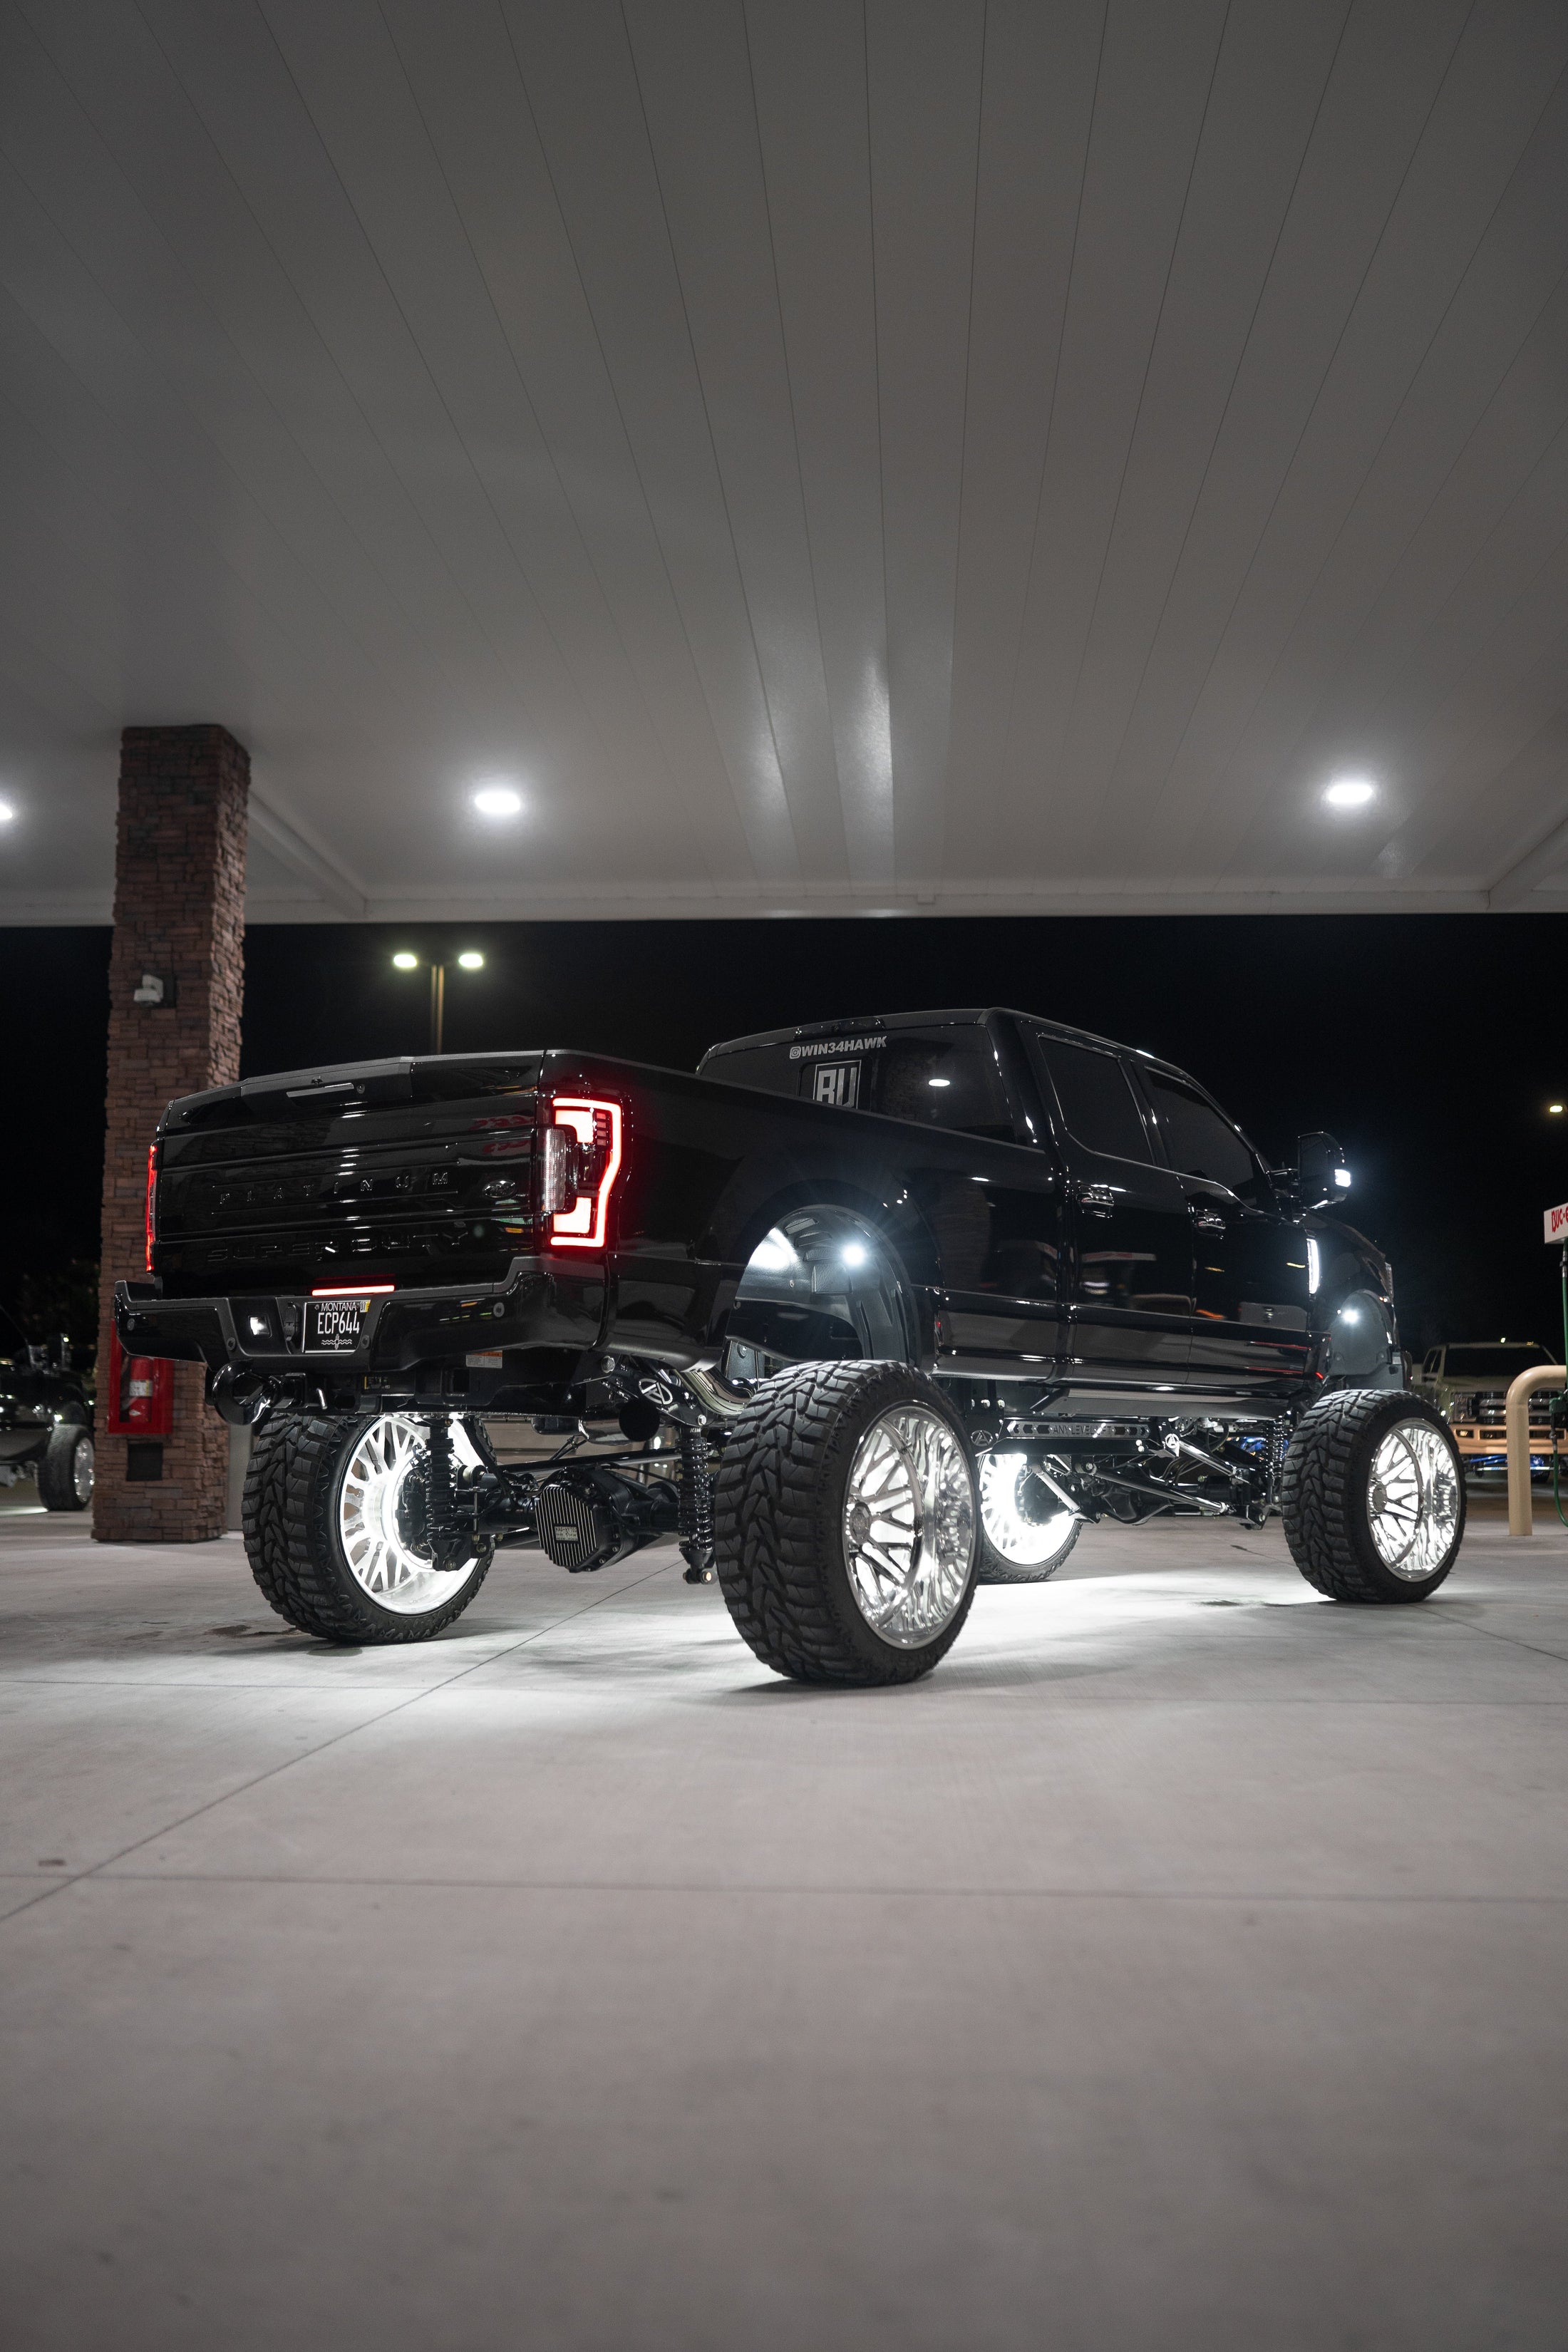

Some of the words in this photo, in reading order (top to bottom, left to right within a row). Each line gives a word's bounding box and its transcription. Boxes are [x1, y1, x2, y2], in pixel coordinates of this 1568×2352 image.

[219, 1171, 449, 1205] PLATINUM
[207, 1239, 340, 1262] SUPER
[351, 1230, 469, 1254] DUTY
[321, 1301, 357, 1311] MONTANA
[317, 1311, 360, 1334] ECP644
